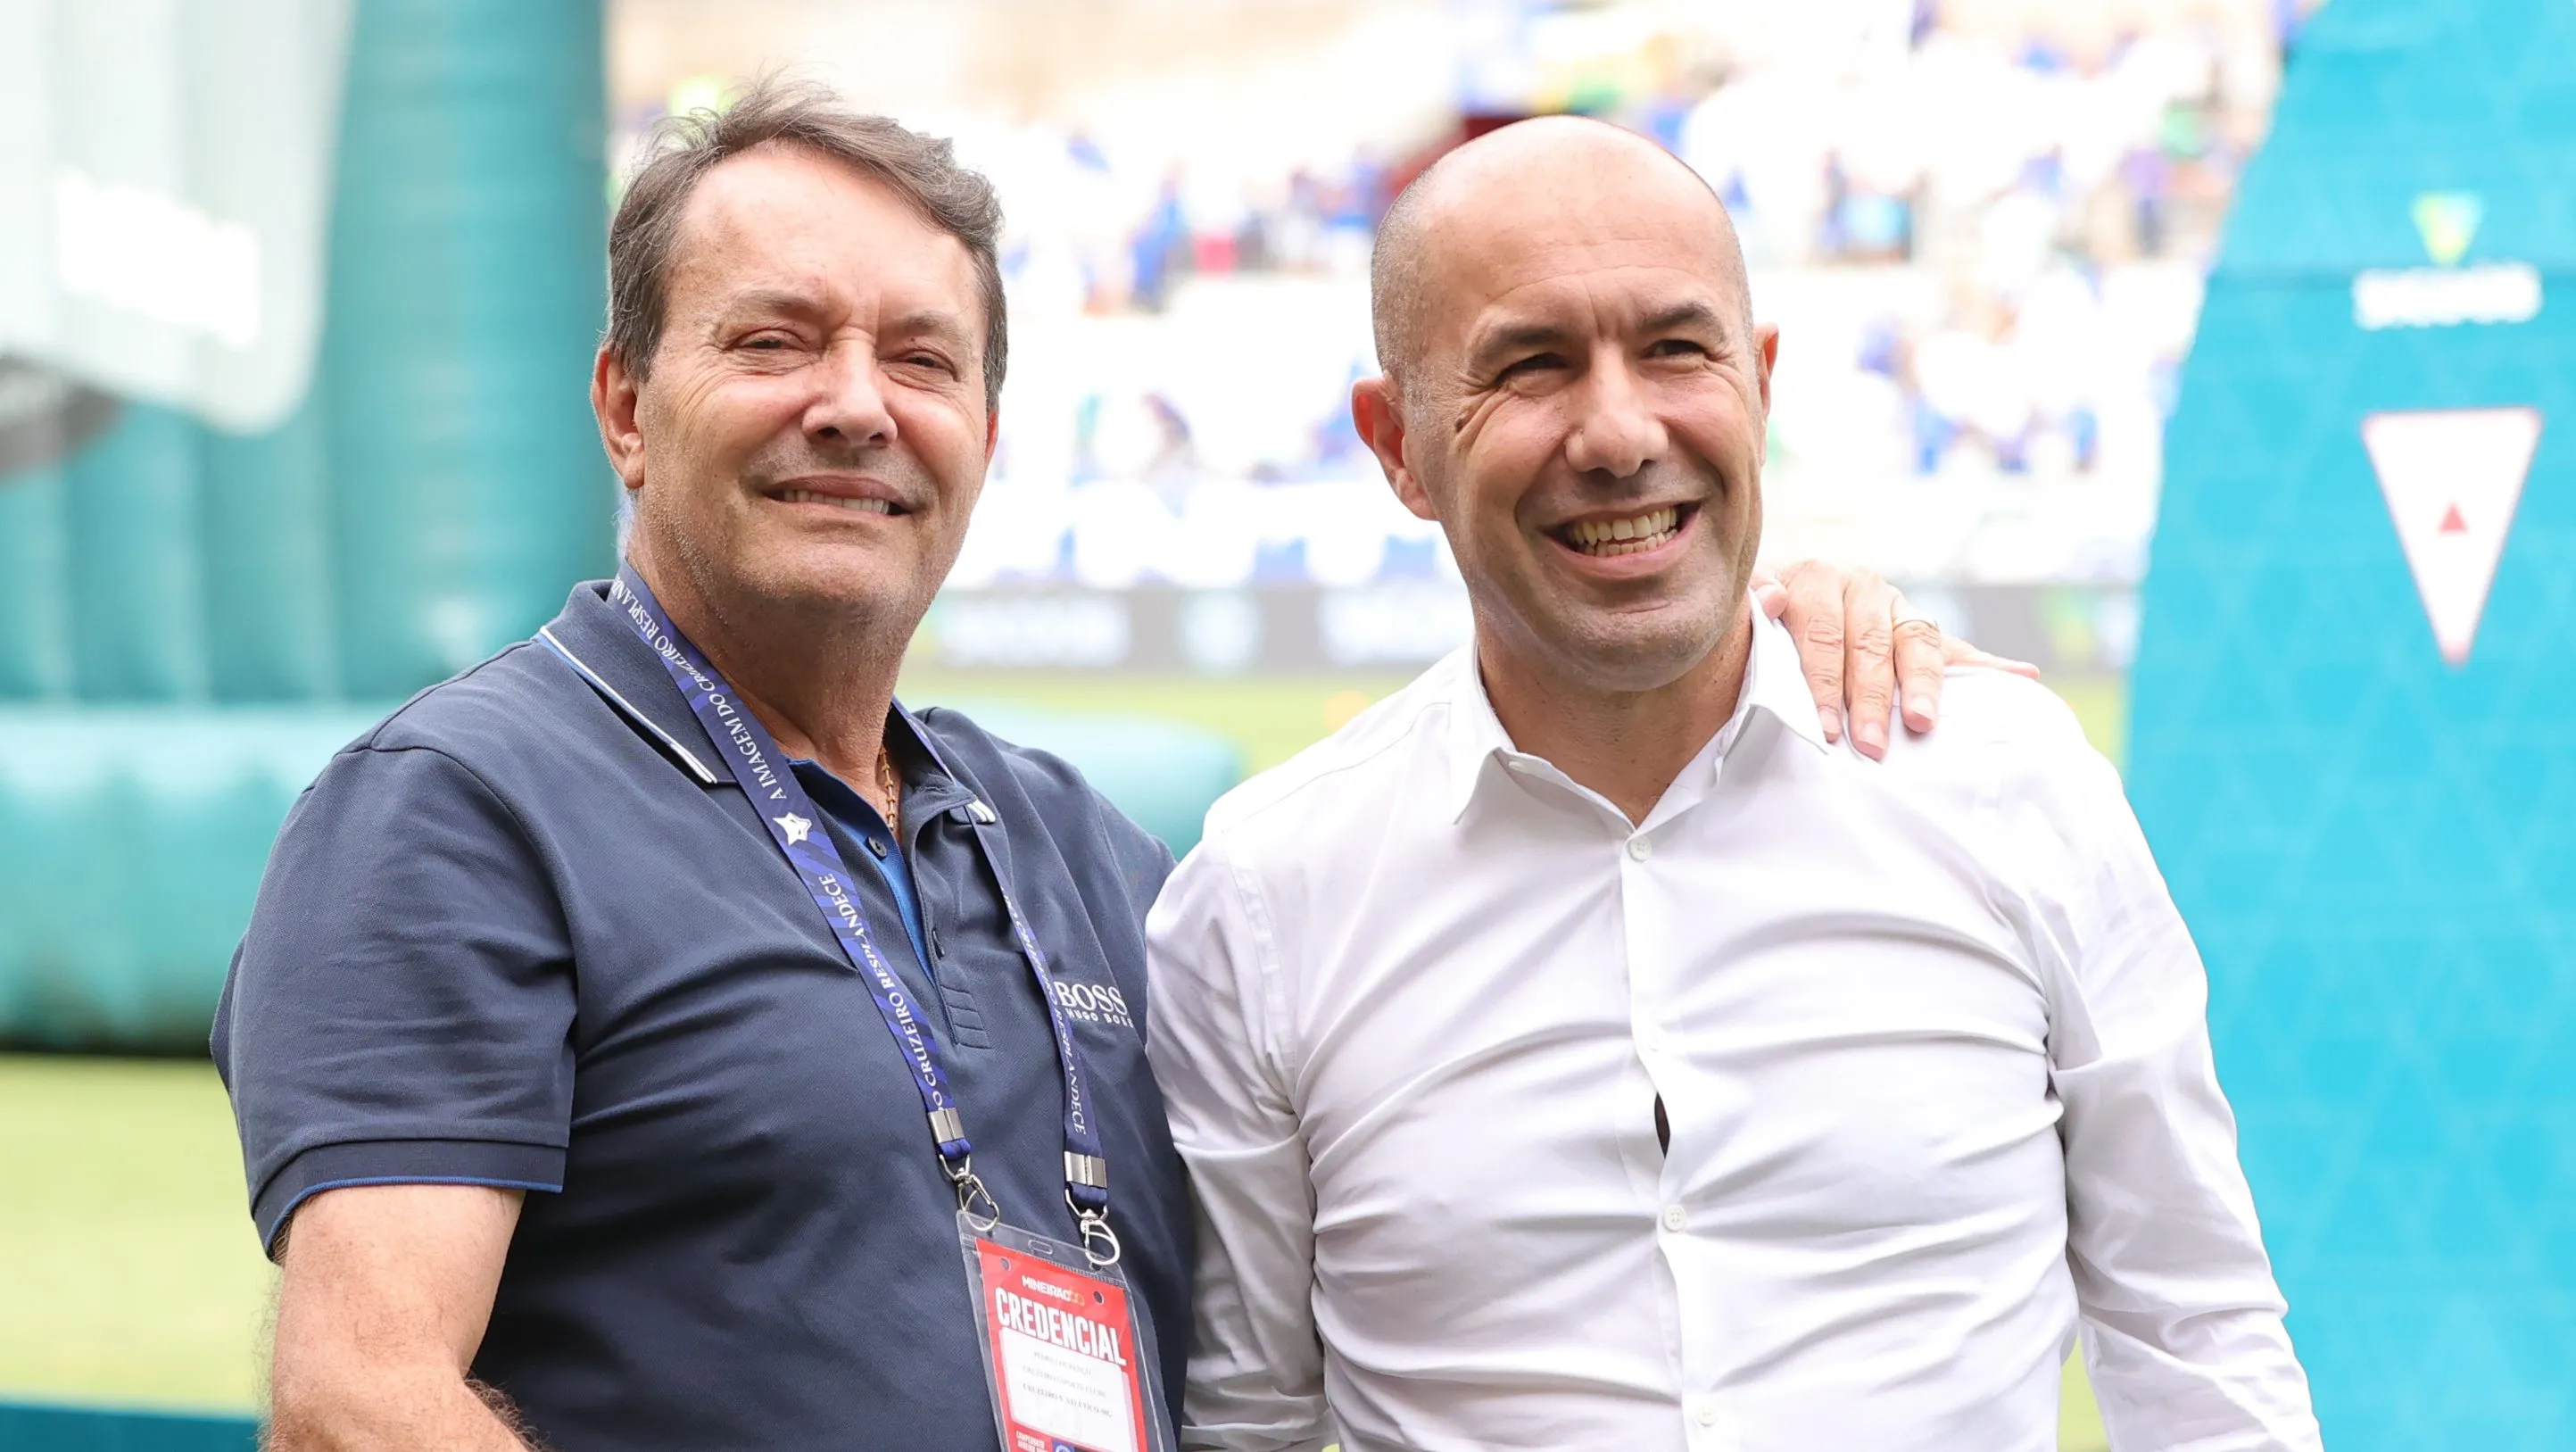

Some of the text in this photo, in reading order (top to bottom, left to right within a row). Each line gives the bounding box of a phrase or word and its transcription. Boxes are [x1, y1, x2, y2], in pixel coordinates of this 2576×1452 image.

[611, 576, 788, 801] A IMAGEM DO CRUZEIRO RESPLAND
[818, 873, 944, 1111] O CRUZEIRO RESPLANDECE
[1053, 981, 1128, 1016] BOSS
[1064, 1007, 1099, 1022] HUGO
[1054, 1008, 1087, 1135] RESPLANDECE
[995, 1287, 1127, 1366] CREDENCIAL
